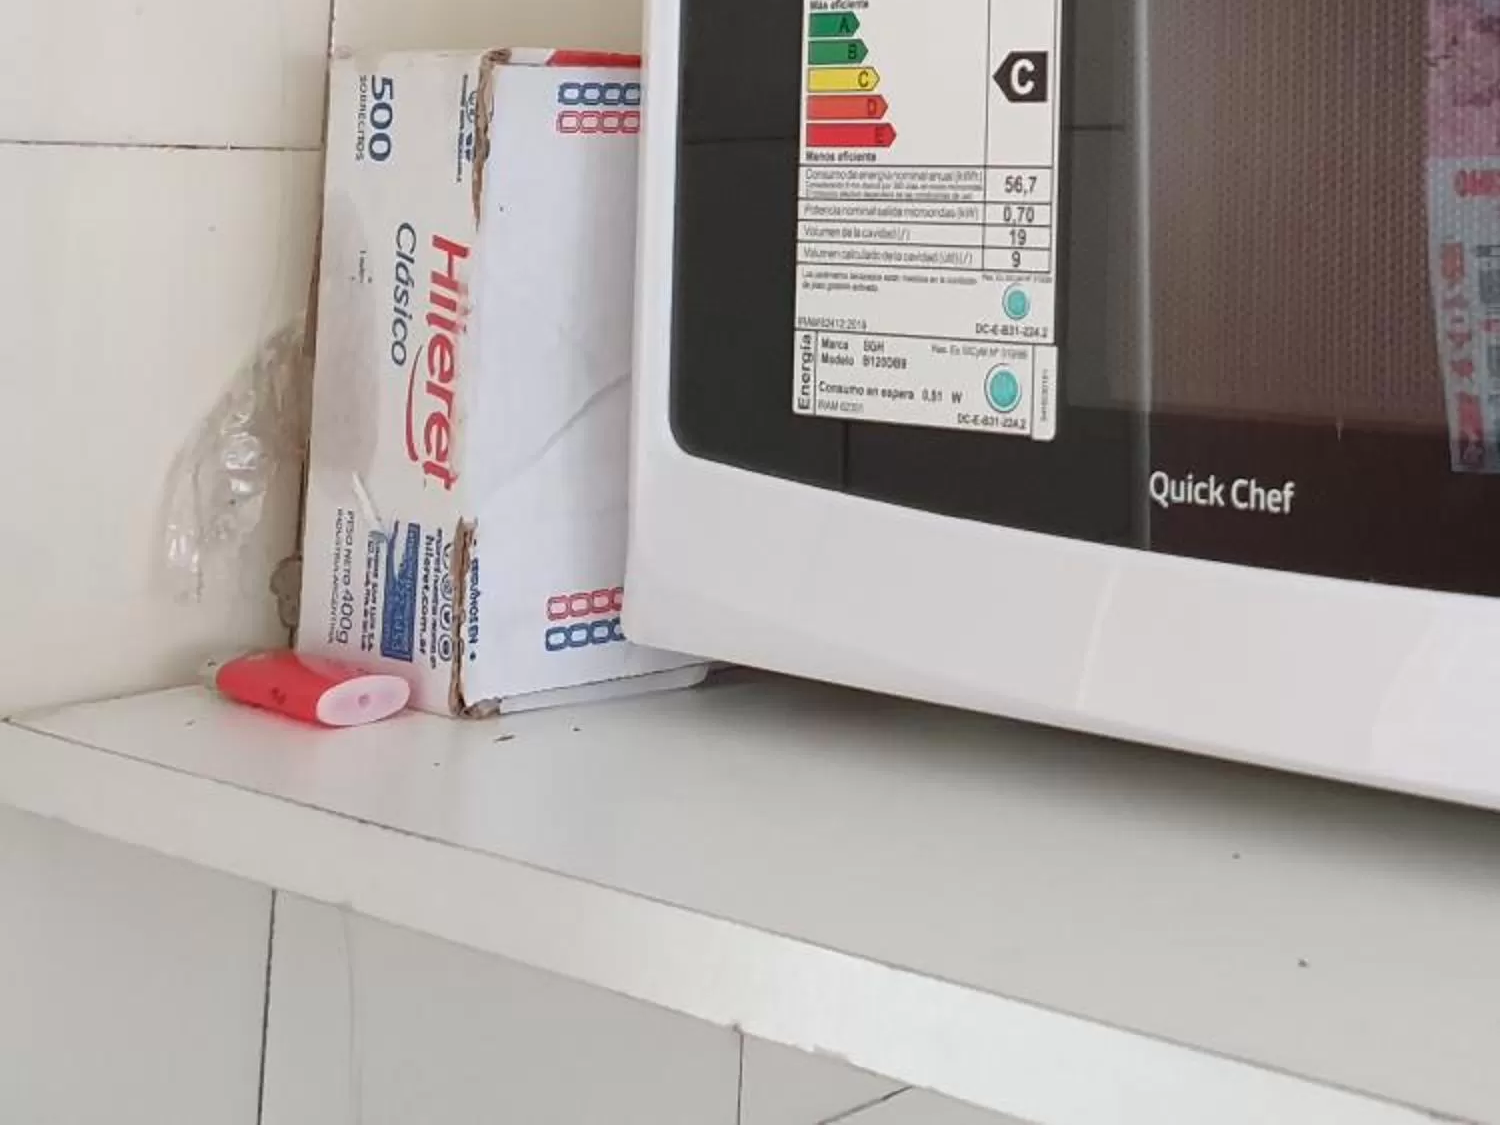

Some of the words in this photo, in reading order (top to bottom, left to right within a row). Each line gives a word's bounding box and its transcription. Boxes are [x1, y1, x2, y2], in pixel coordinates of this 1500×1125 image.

[839, 17, 851, 33] A
[847, 44, 858, 59] B
[857, 71, 869, 88] C
[1010, 58, 1035, 95] C
[866, 99, 877, 115] D
[355, 75, 367, 162] SOBRECITOS
[367, 74, 394, 162] 500
[875, 127, 884, 144] E
[805, 151, 836, 162] Menos
[1004, 176, 1037, 196] 56,7
[1009, 229, 1026, 246] 19
[1011, 251, 1021, 268] 9
[391, 222, 417, 367] Clásico
[821, 338, 849, 350] Marca
[863, 341, 884, 352] BGH
[422, 234, 472, 491] Hileret
[821, 353, 854, 366] Modelo
[798, 334, 813, 410] Energía
[819, 381, 864, 396] Consumo
[866, 387, 878, 396] en
[881, 389, 914, 401] espera
[951, 392, 962, 404] W
[1150, 470, 1225, 509] Quick
[1231, 478, 1296, 515] Chef
[419, 535, 434, 655] hileret.com.ar
[336, 590, 355, 644] 400g
